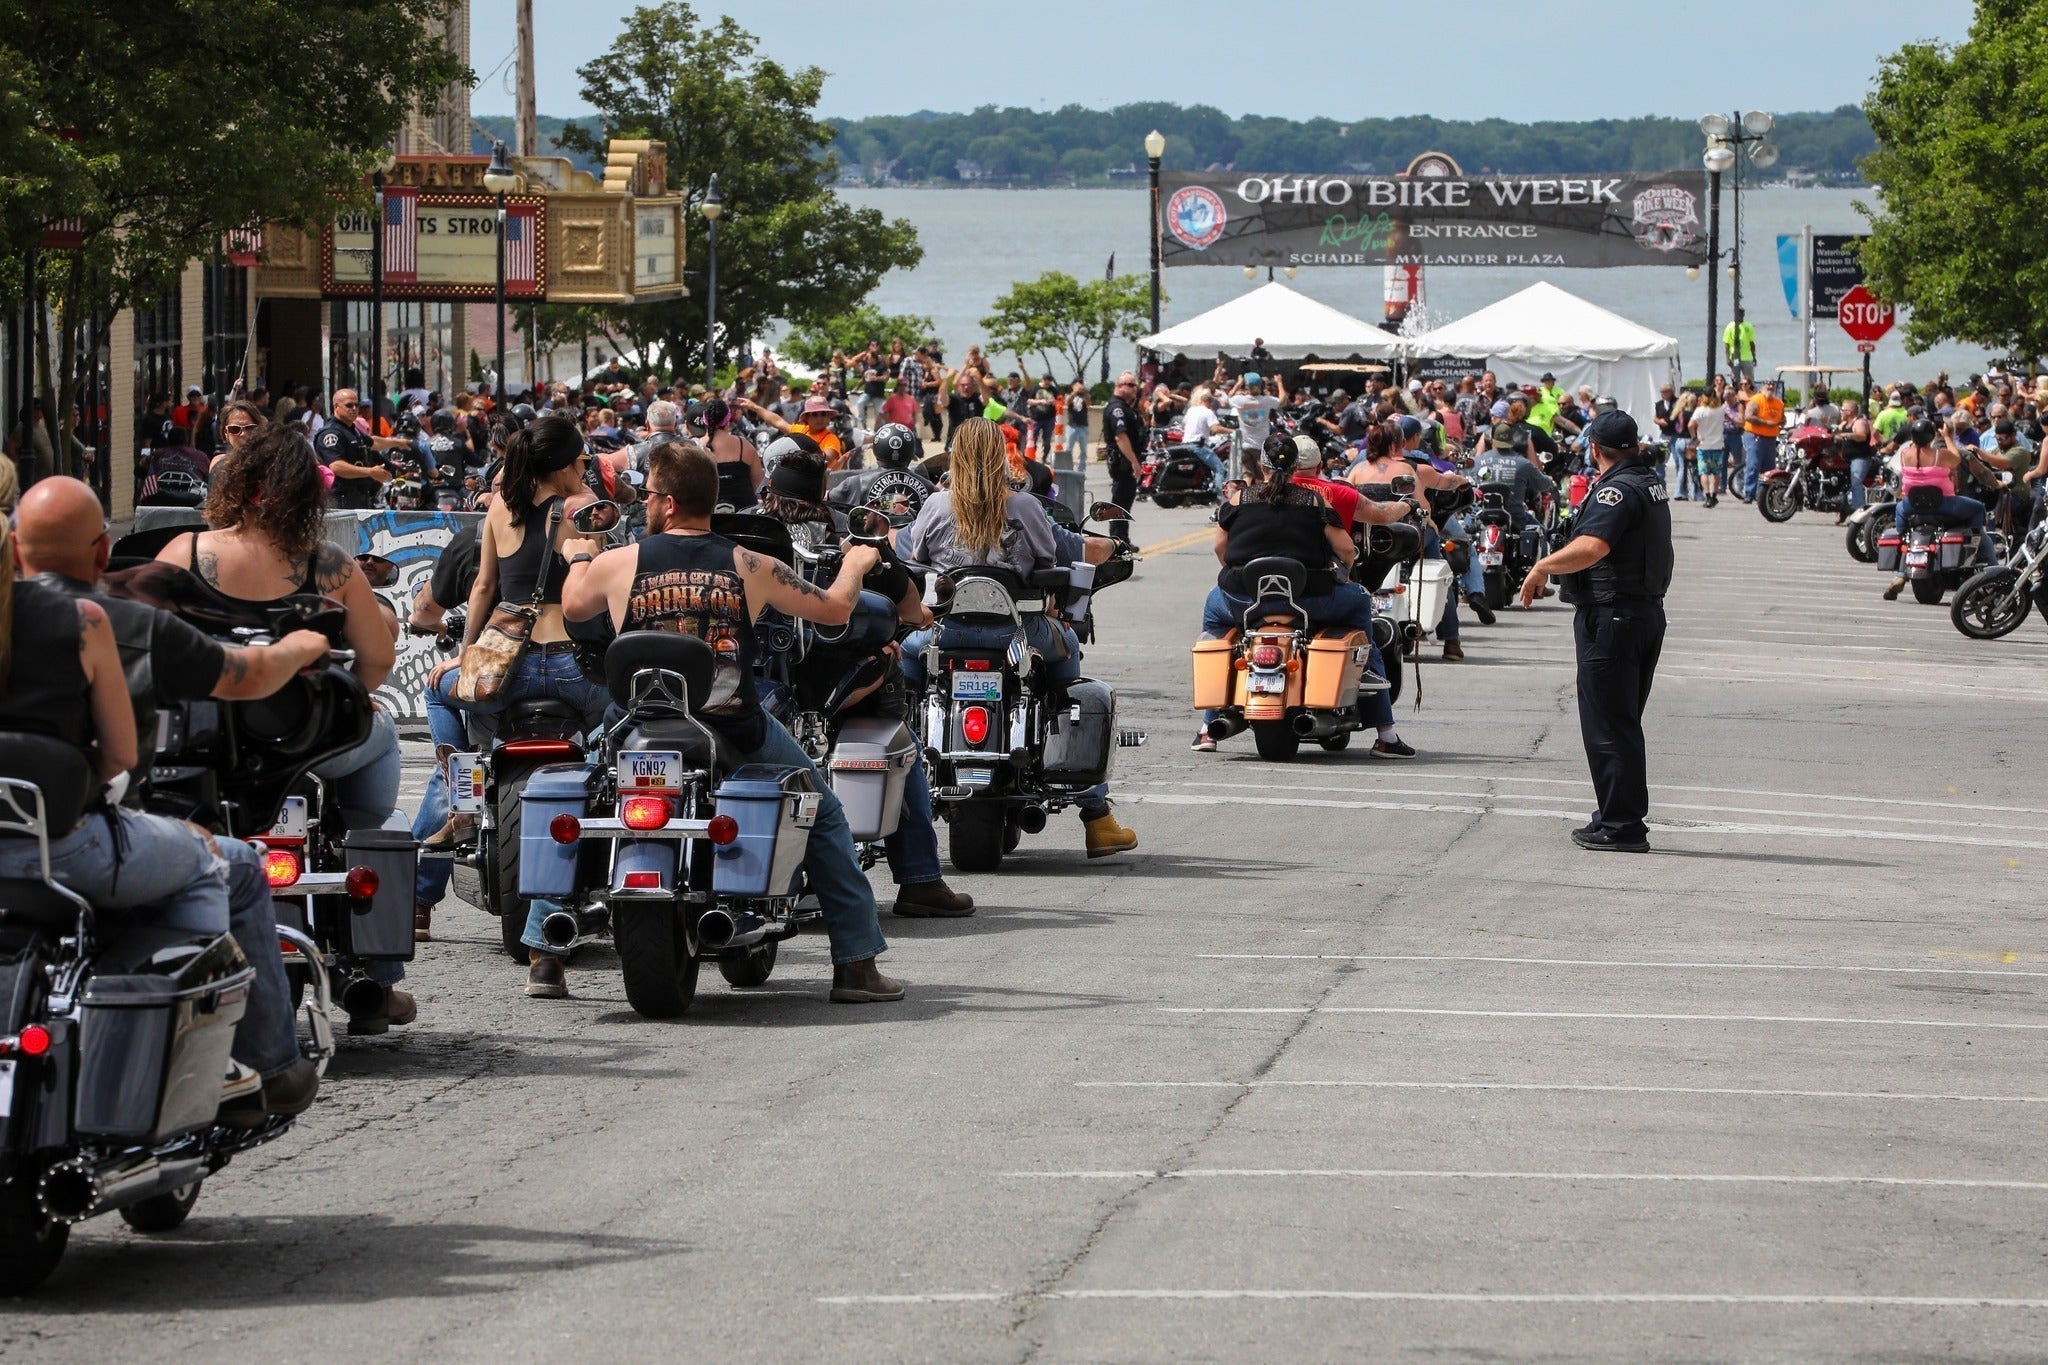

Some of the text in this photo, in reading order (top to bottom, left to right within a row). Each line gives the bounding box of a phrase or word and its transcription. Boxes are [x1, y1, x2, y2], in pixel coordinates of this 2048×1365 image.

[1237, 177, 1622, 207] OHIO BIKE WEEK
[1408, 224, 1538, 238] ENTRANCE
[1290, 253, 1365, 265] SCHADE
[1395, 253, 1499, 265] MYLANDER
[1507, 254, 1566, 265] PLAZA
[1816, 257, 1843, 265] Jackson
[1833, 267, 1856, 275] Launch
[1842, 303, 1892, 325] STOP
[1433, 359, 1472, 367] OFFICIAL
[648, 572, 687, 589] WANNA
[689, 571, 713, 585] GET
[631, 584, 744, 624] DRINK ON
[959, 681, 998, 691] 5R182
[632, 760, 666, 776] KGN92
[457, 768, 472, 800] KVN76
